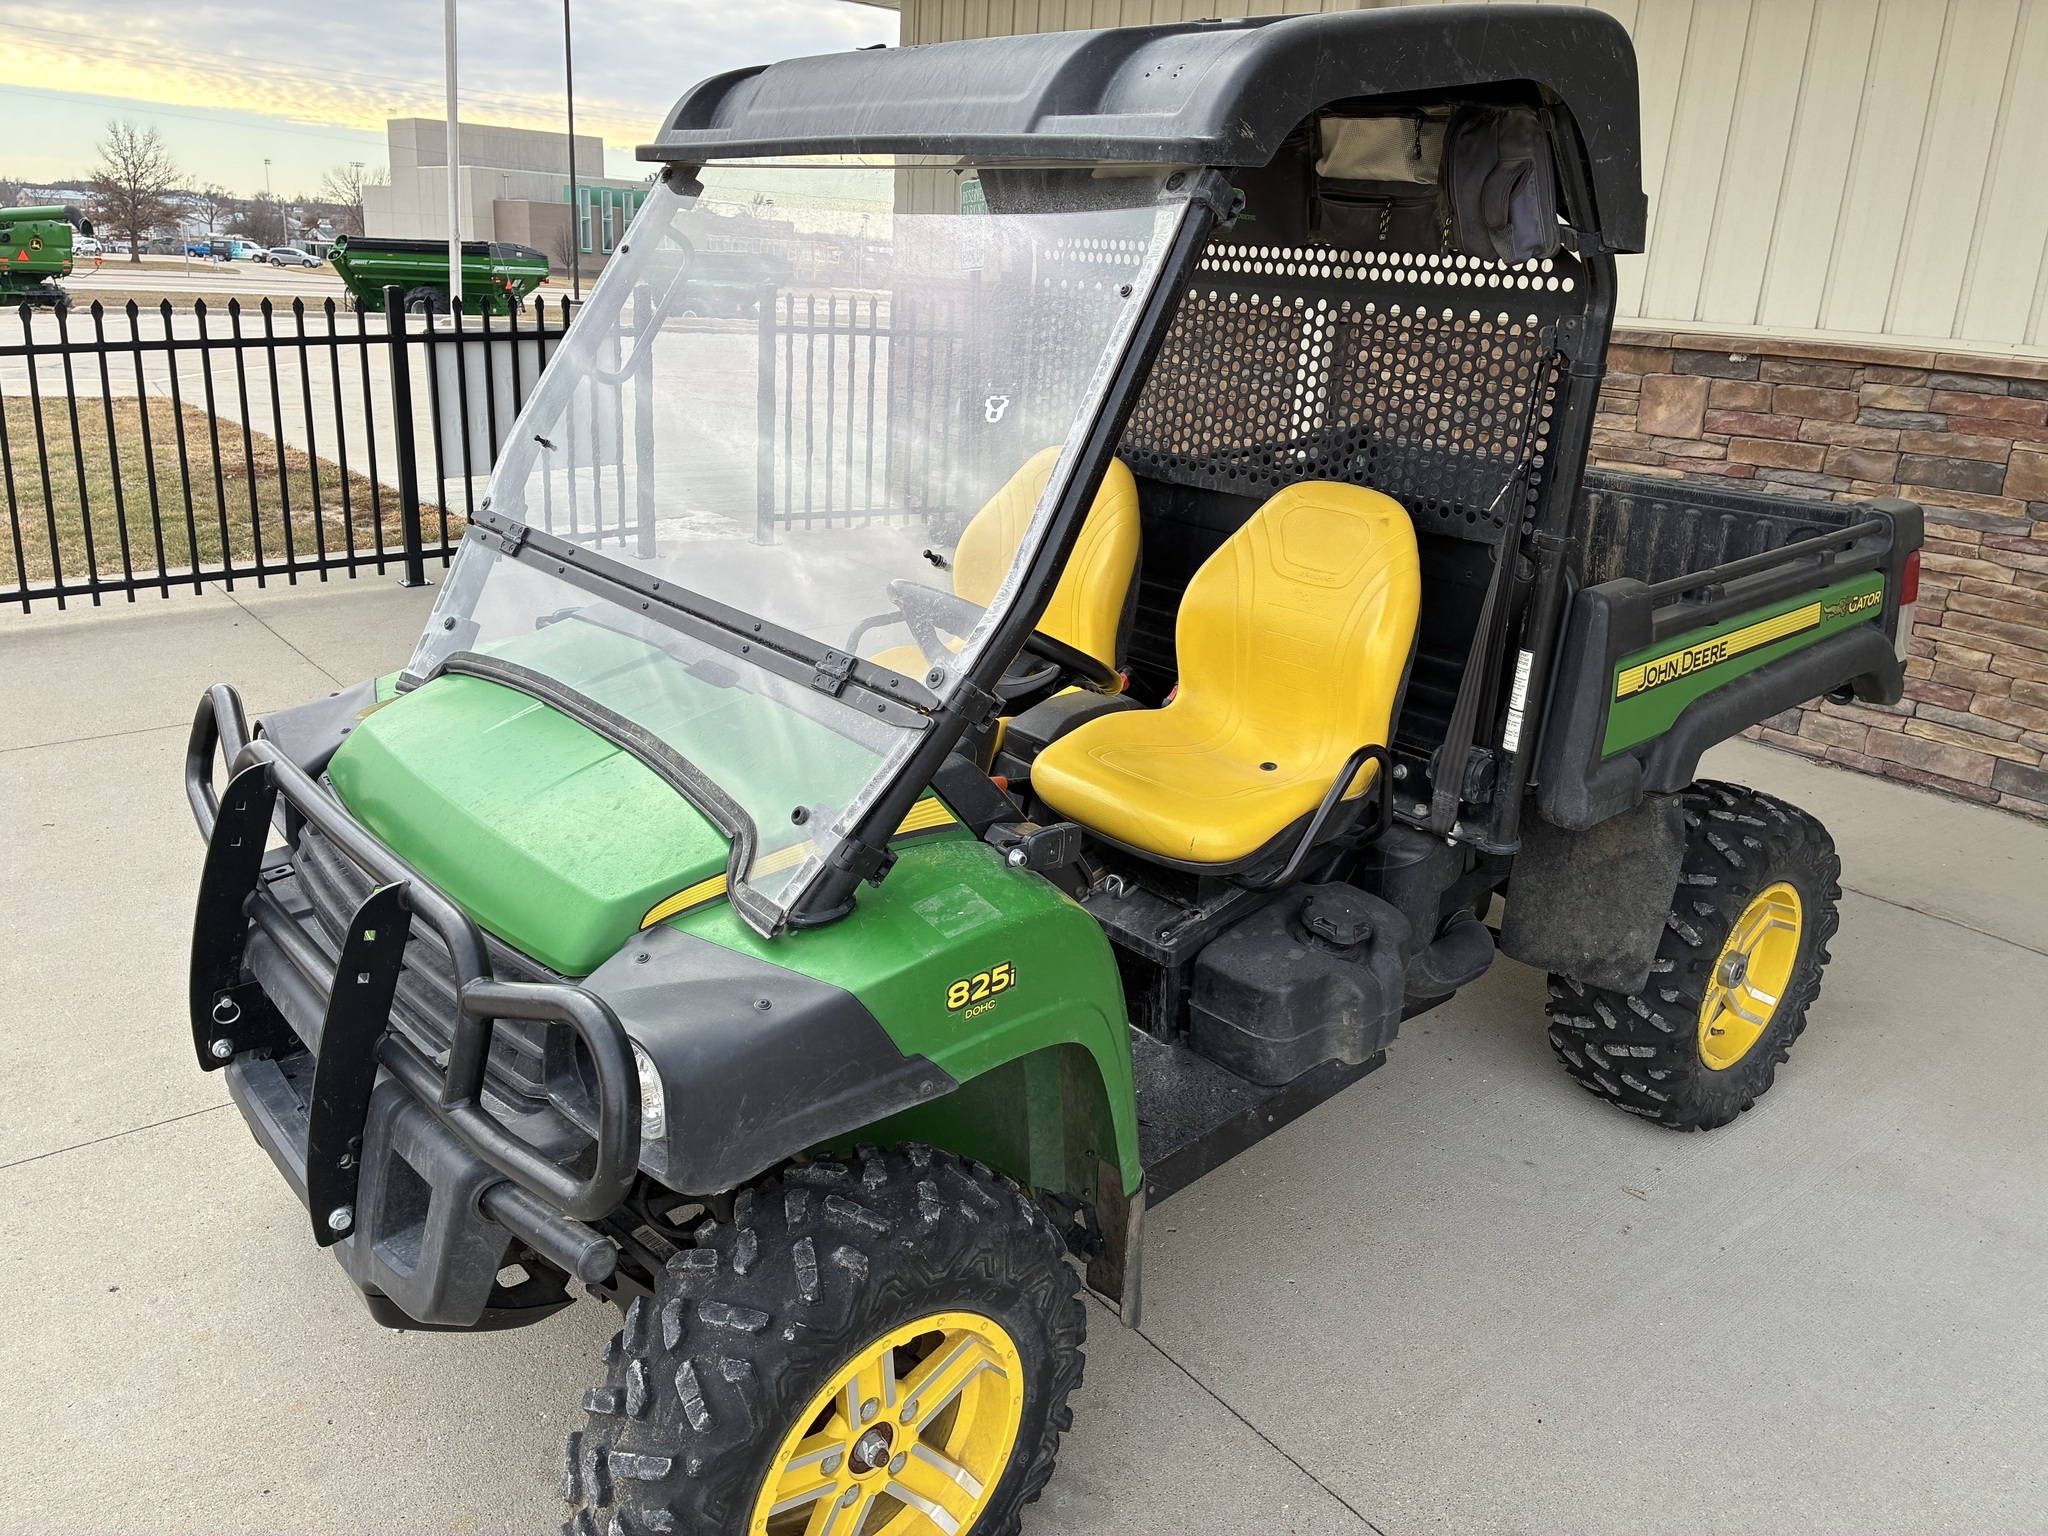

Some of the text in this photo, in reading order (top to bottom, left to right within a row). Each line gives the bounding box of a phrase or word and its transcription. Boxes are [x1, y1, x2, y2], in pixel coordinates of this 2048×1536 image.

[1848, 590, 1882, 614] GATOR
[1637, 640, 1729, 690] JOHN DEERE
[946, 961, 1017, 1010] 825i
[964, 999, 997, 1020] DOHC
